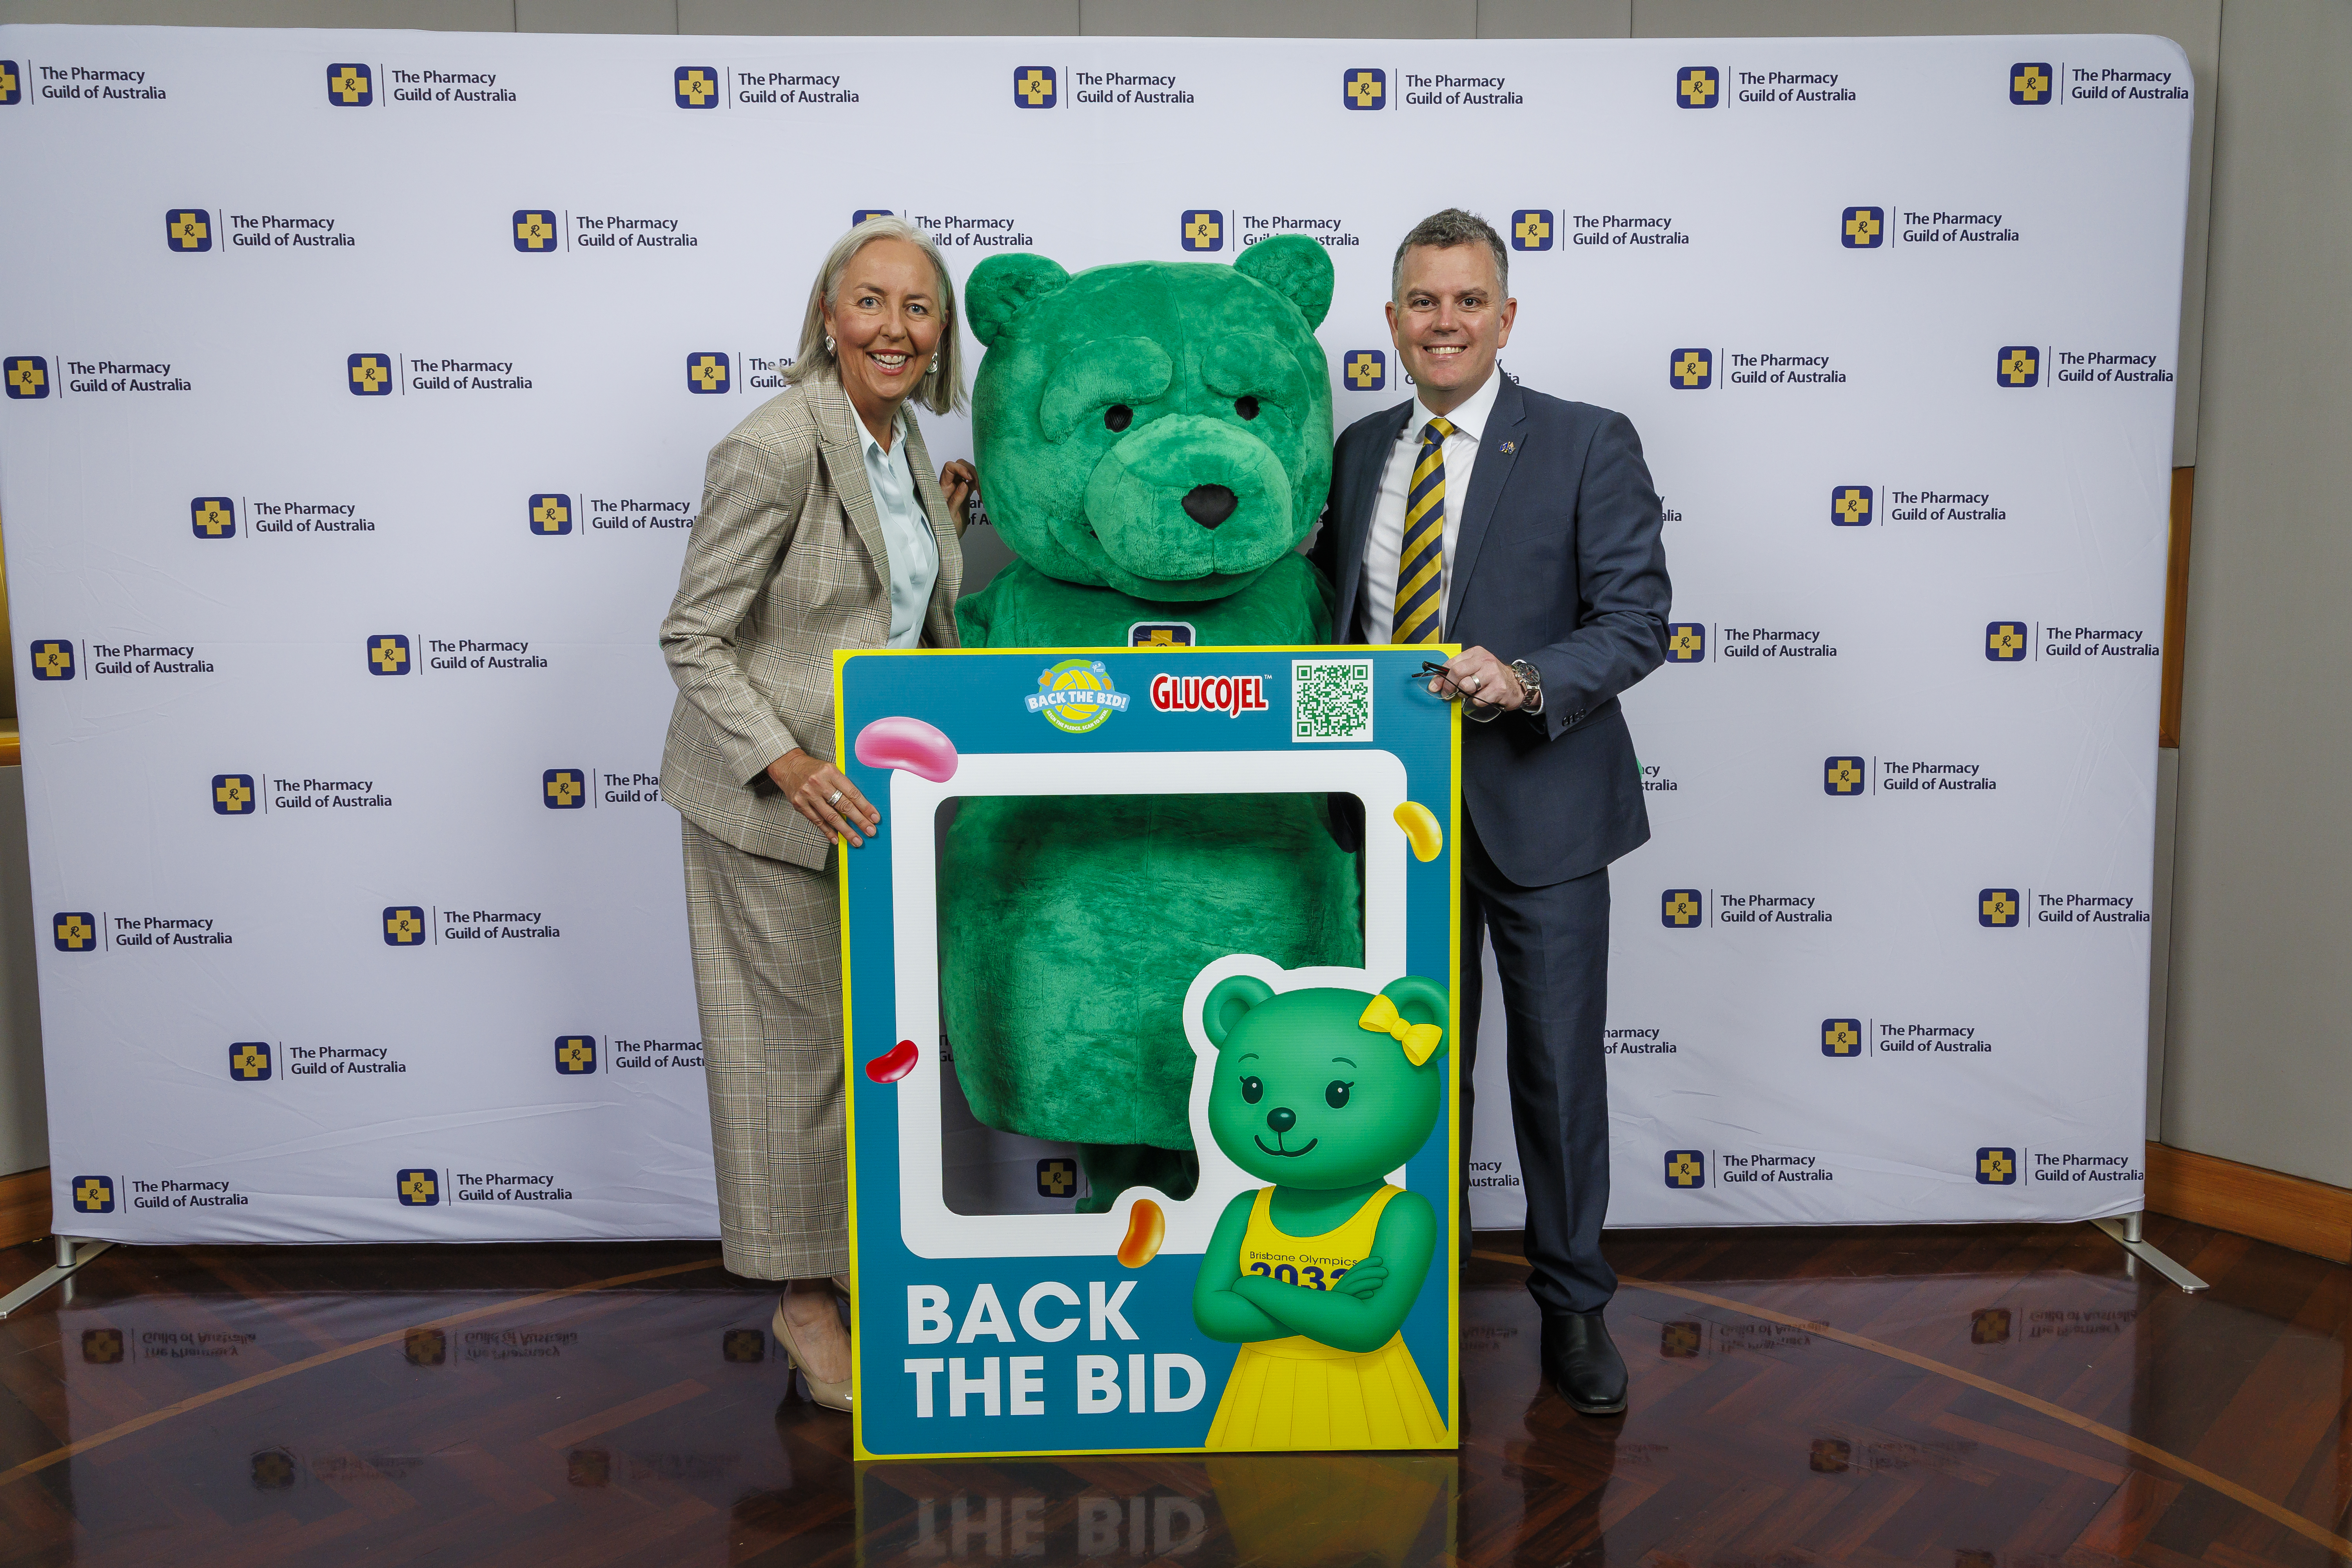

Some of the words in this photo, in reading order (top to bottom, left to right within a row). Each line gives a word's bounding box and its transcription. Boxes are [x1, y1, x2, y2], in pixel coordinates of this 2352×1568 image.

[39, 66, 68, 80] The
[71, 67, 145, 85] Pharmacy
[738, 73, 765, 85] The
[769, 73, 840, 89] Pharmacy
[1076, 72, 1103, 85] The
[1106, 72, 1176, 89] Pharmacy
[1739, 72, 1765, 85] The
[1769, 71, 1838, 87] Pharmacy
[2072, 68, 2098, 81] The
[2102, 68, 2172, 85] Pharmacy
[42, 85, 81, 98] Guild
[84, 85, 100, 99] of
[102, 86, 166, 99] Australia
[739, 90, 777, 103] Guild
[780, 90, 795, 103] of
[798, 89, 859, 103] Australia
[1077, 90, 1113, 103] Guild
[1117, 90, 1132, 103] of
[1134, 90, 1194, 103] Australia
[1739, 89, 1775, 102] Guild
[1779, 88, 1794, 102] of
[1796, 88, 1856, 102] Australia
[2072, 86, 2108, 99] Guild
[2111, 86, 2127, 99] of
[2128, 86, 2189, 99] Australia
[576, 216, 604, 229] The
[607, 216, 679, 232] Pharmacy
[915, 216, 941, 229] The
[945, 216, 1014, 232] Pharmacy
[1243, 216, 1269, 229] The
[1272, 216, 1341, 232] Pharmacy
[1904, 212, 1929, 225] The
[1933, 212, 2002, 227] Pharmacy
[578, 233, 615, 246] Guild
[619, 233, 634, 246] of
[636, 233, 698, 246] Australia
[955, 233, 971, 246] of
[973, 233, 1033, 246] Australia
[1903, 229, 1939, 242] Guild
[1942, 229, 1958, 241] of
[1959, 228, 2019, 241] Australia
[1731, 354, 1757, 366] The
[1760, 354, 1829, 369] Pharmacy
[2059, 352, 2085, 365] The
[2088, 352, 2157, 368] Pharmacy
[67, 361, 96, 374] The
[98, 361, 171, 377] Pharmacy
[2058, 369, 2094, 381] Guild
[2097, 368, 2112, 381] of
[2114, 369, 2173, 382] Australia
[1731, 370, 1767, 383] Guild
[1770, 370, 1786, 383] of
[1787, 370, 1846, 383] Australia
[70, 379, 108, 392] Guild
[111, 378, 126, 392] of
[129, 378, 192, 391] Australia
[1892, 491, 1918, 503] The
[1921, 491, 1989, 506] Pharmacy
[590, 499, 617, 512] The
[621, 499, 690, 514] Pharmacy
[1892, 508, 1927, 520] Guild
[1930, 508, 1946, 520] of
[1947, 507, 2006, 520] Australia
[592, 516, 629, 529] Guild
[632, 515, 647, 528] of
[650, 515, 697, 528] Austra
[1724, 628, 1749, 641] The
[1753, 628, 1820, 643] Pharmacy
[93, 644, 120, 657] The
[123, 644, 194, 659] Pharmacy
[1724, 644, 1759, 657] Guild
[1762, 644, 1777, 657] of
[1779, 644, 1837, 657] Australia
[95, 661, 132, 674] Guild
[135, 661, 151, 673] of
[153, 660, 214, 673] Australia
[1028, 691, 1066, 710] BACK
[1068, 691, 1094, 703] THE
[1097, 692, 1127, 709] BID!
[1152, 675, 1267, 717] GLUCOJEL
[1046, 710, 1057, 722] SIGN
[1082, 722, 1094, 730] SCAN
[1098, 709, 1109, 721] WIN.
[1884, 762, 1909, 773] The
[1912, 761, 1980, 777] Pharmacy
[273, 779, 300, 791] The
[303, 779, 373, 793] Pharmacy
[603, 773, 630, 786] The
[1884, 778, 1918, 790] Guild
[1922, 777, 1937, 790] of
[1938, 777, 1996, 790] Australia
[275, 795, 312, 808] Guild
[315, 795, 330, 808] of
[332, 794, 392, 807] Australia
[605, 789, 641, 802] Guild
[644, 789, 659, 802] of
[2038, 894, 2063, 906] The
[2067, 894, 2134, 909] Pharmacy
[2038, 910, 2073, 922] Guild
[2076, 910, 2091, 922] of
[2092, 910, 2150, 922] Australia
[114, 917, 141, 929] The
[144, 916, 214, 931] Pharmacy
[116, 933, 152, 946] Guild
[155, 933, 171, 945] of
[172, 932, 232, 945] Australia
[1880, 1024, 1905, 1036] The
[1908, 1024, 1975, 1039] Pharmacy
[614, 1040, 641, 1052] The
[644, 1039, 703, 1052] Pharmac
[1604, 1042, 1619, 1054] of
[1620, 1041, 1677, 1054] Australia
[1880, 1040, 1915, 1051] Guild
[1917, 1040, 1933, 1051] of
[1934, 1040, 1992, 1052] Australia
[289, 1046, 316, 1058] The
[319, 1046, 388, 1060] Pharmacy
[291, 1062, 327, 1074] Guild
[330, 1062, 345, 1074] of
[347, 1061, 406, 1073] Australia
[616, 1056, 651, 1068] Guild
[654, 1055, 669, 1067] of
[2034, 1153, 2060, 1165] The
[2063, 1154, 2129, 1169] Pharmacy
[456, 1173, 483, 1185] The
[486, 1173, 554, 1187] Pharmacy
[2035, 1169, 2069, 1181] Guild
[2072, 1169, 2087, 1181] of
[2088, 1169, 2144, 1181] Australia
[458, 1189, 494, 1201] Guild
[497, 1189, 512, 1200] of
[514, 1188, 573, 1200] Australia
[1250, 1251, 1296, 1262] Brisbane
[1299, 1254, 1357, 1267] Olympics
[907, 1280, 1140, 1345] BACK
[904, 1356, 1045, 1418] THE
[1076, 1353, 1206, 1414] BID
